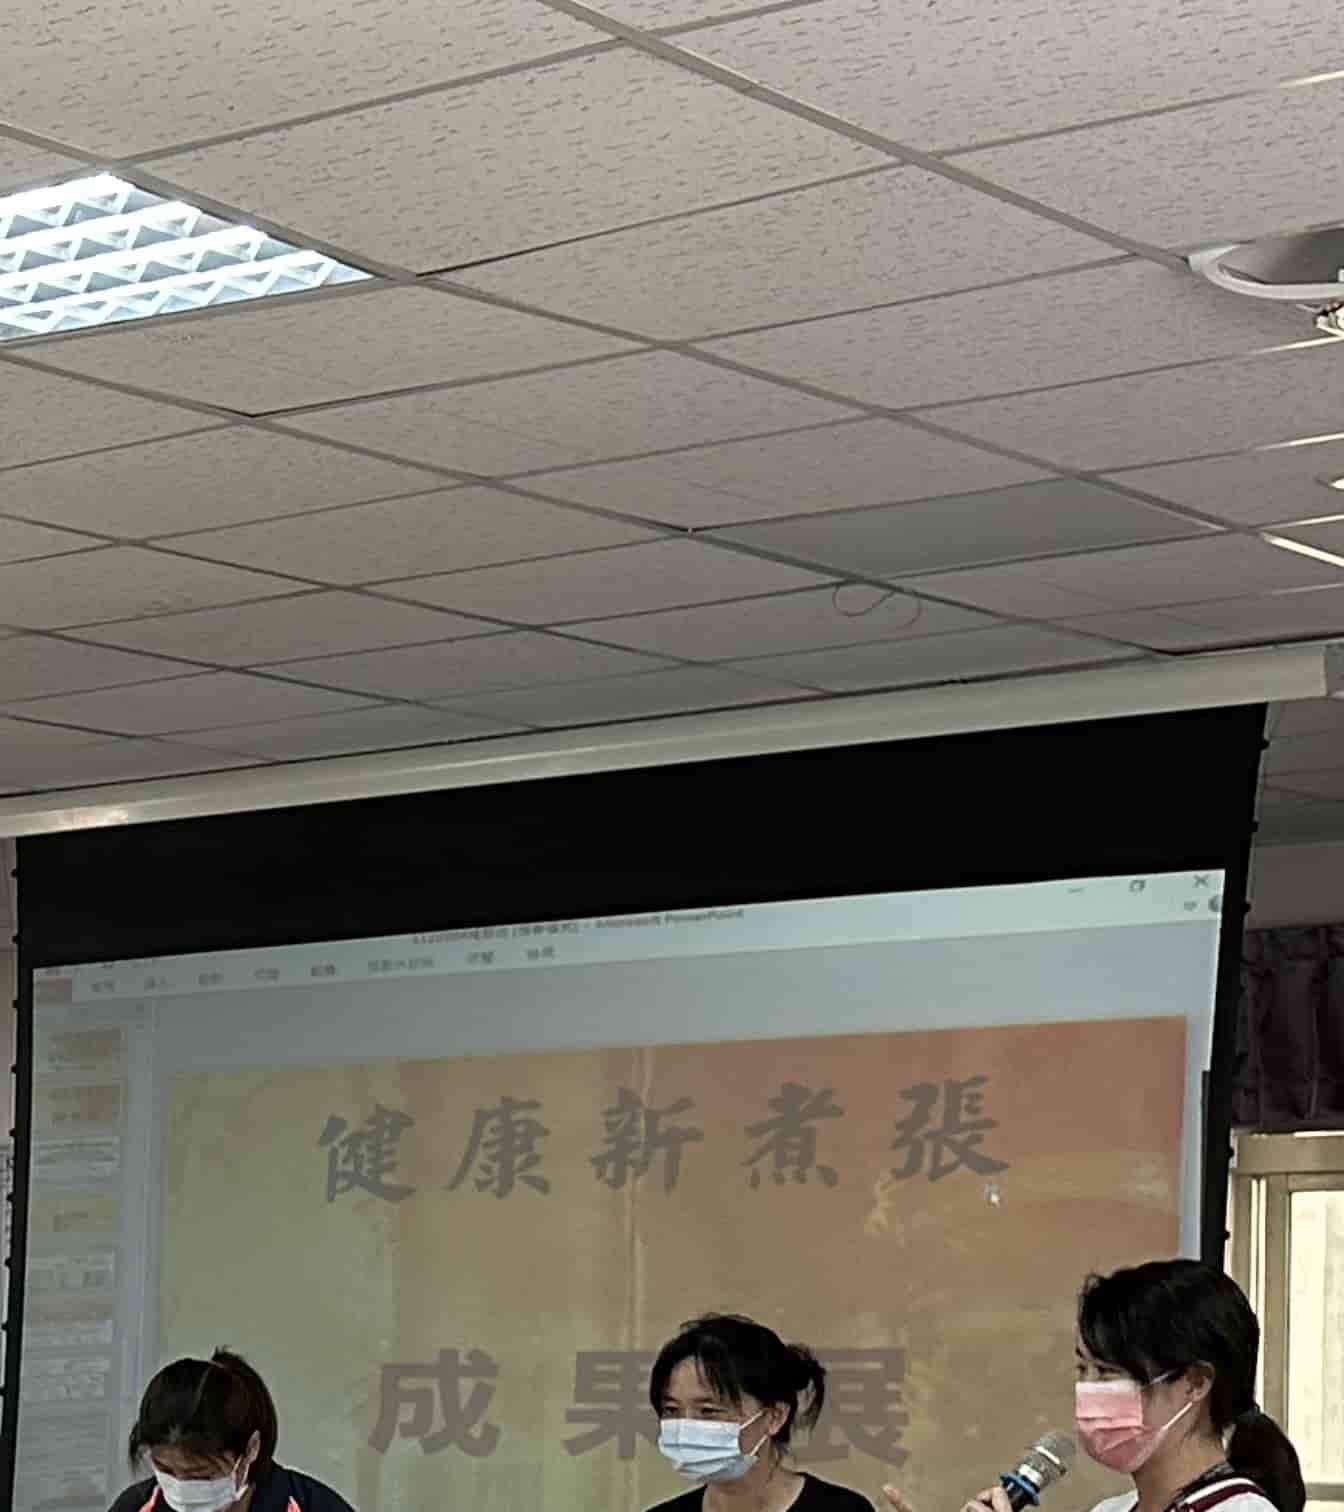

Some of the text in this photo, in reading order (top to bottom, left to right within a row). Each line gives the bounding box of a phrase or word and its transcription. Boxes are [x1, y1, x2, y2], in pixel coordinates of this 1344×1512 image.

[317, 1077, 1010, 1203] 健康新煮張
[367, 1346, 912, 1468] 成果展
